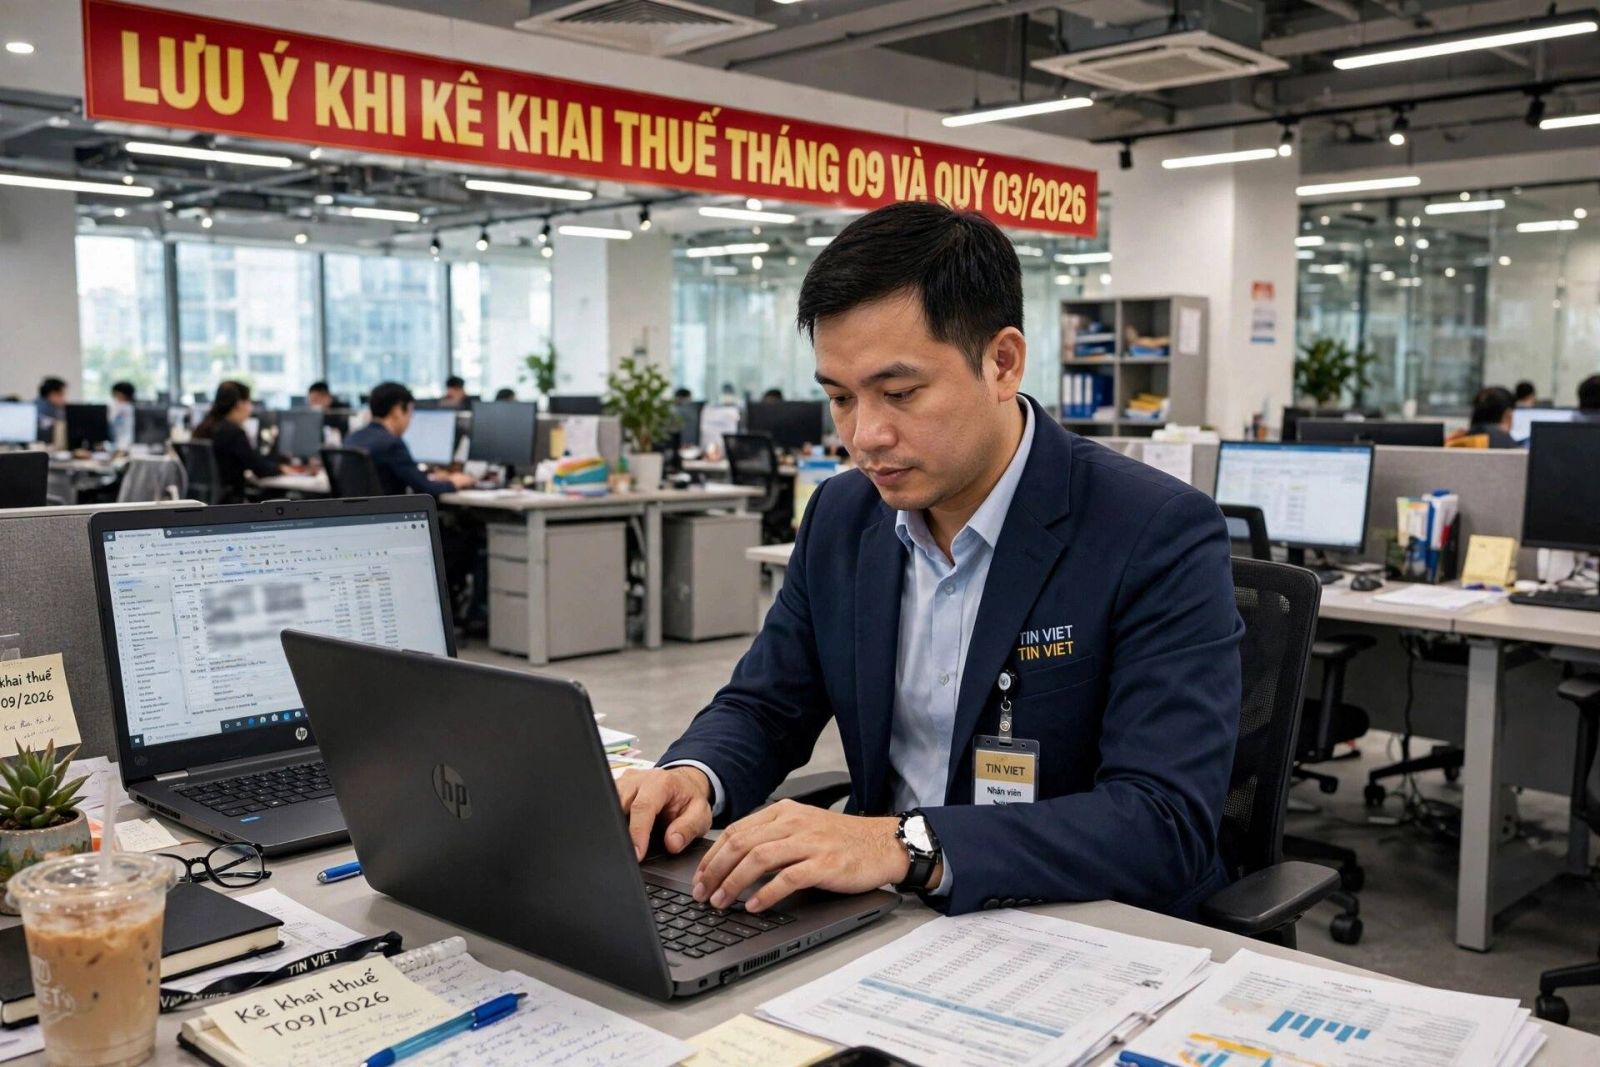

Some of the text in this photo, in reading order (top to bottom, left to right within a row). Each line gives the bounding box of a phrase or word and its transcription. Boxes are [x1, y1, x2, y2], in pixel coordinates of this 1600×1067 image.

[122, 32, 1087, 225] LƯU Ý KHI KÊ KHAI THUẾ THÁNG 09 VÀ QUÝ 03/2026
[1020, 625, 1073, 645] TIN VIET
[1017, 641, 1074, 661] TIN VIET
[26, 668, 53, 684] thuế
[985, 763, 1026, 776] TIN VIET
[440, 764, 467, 818] hp
[1007, 788, 1022, 797] viên
[288, 950, 338, 976] TIN VIET
[235, 1004, 270, 1024] Kê
[274, 988, 324, 1012] khai
[328, 968, 380, 994] thuế
[264, 991, 391, 1037] T09/2026
